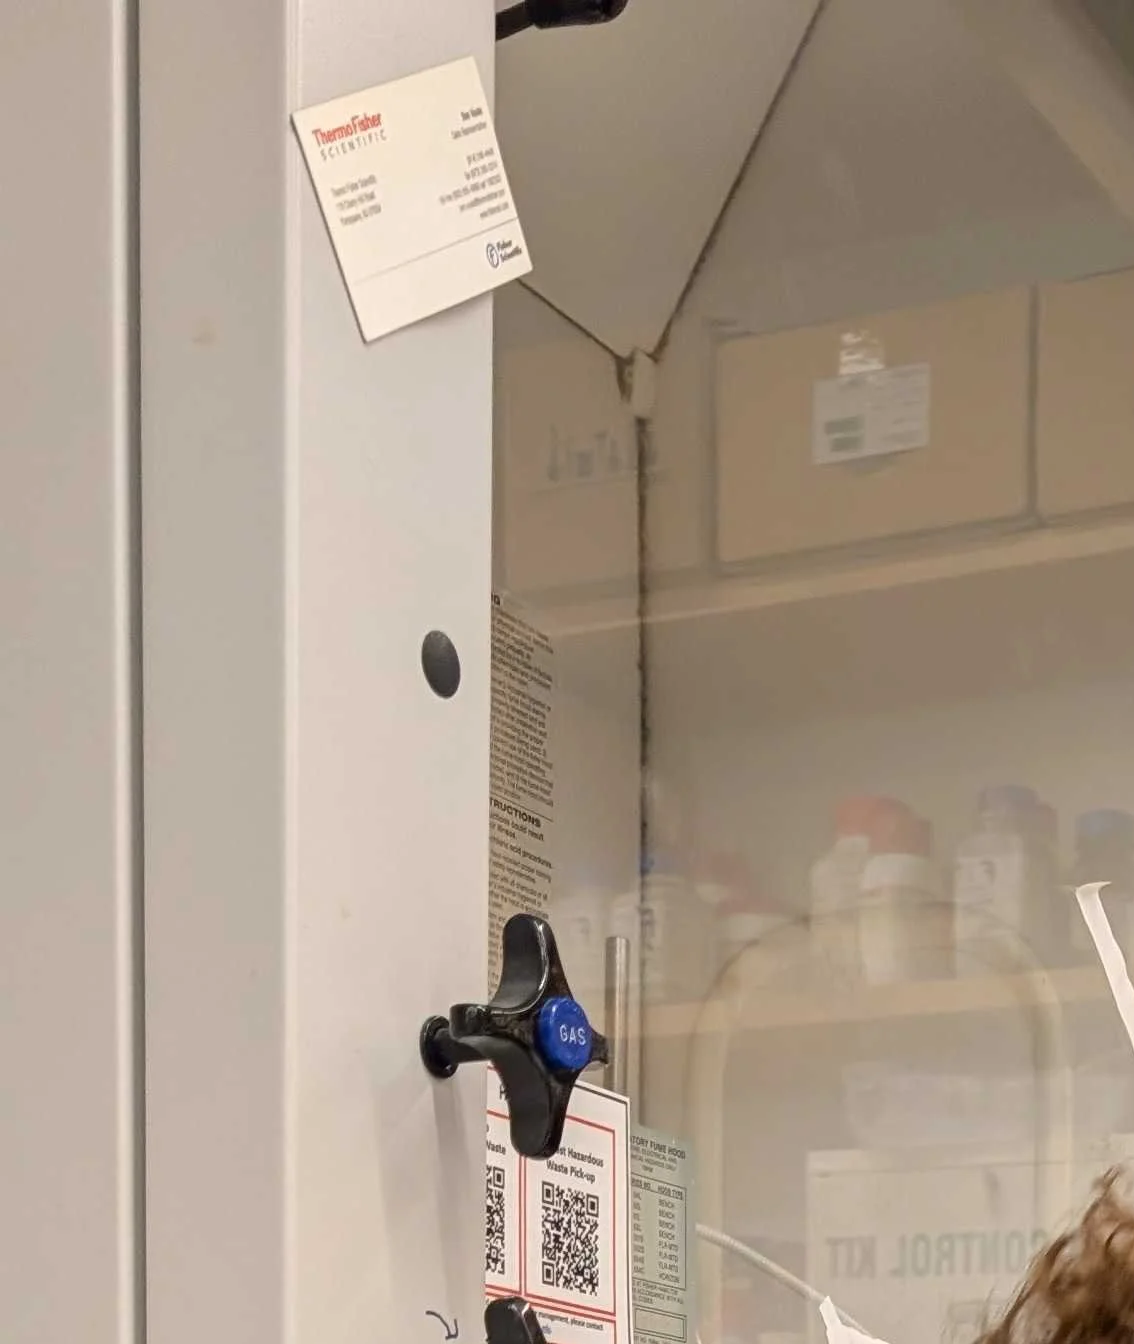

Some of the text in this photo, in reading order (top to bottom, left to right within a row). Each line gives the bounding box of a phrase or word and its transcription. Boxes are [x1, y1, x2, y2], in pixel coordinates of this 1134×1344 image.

[319, 129, 388, 162] SCIENTIFIC
[559, 1024, 586, 1046] GAS
[567, 1147, 604, 1168] Hazardous
[546, 1160, 595, 1183] Waste Pick-up
